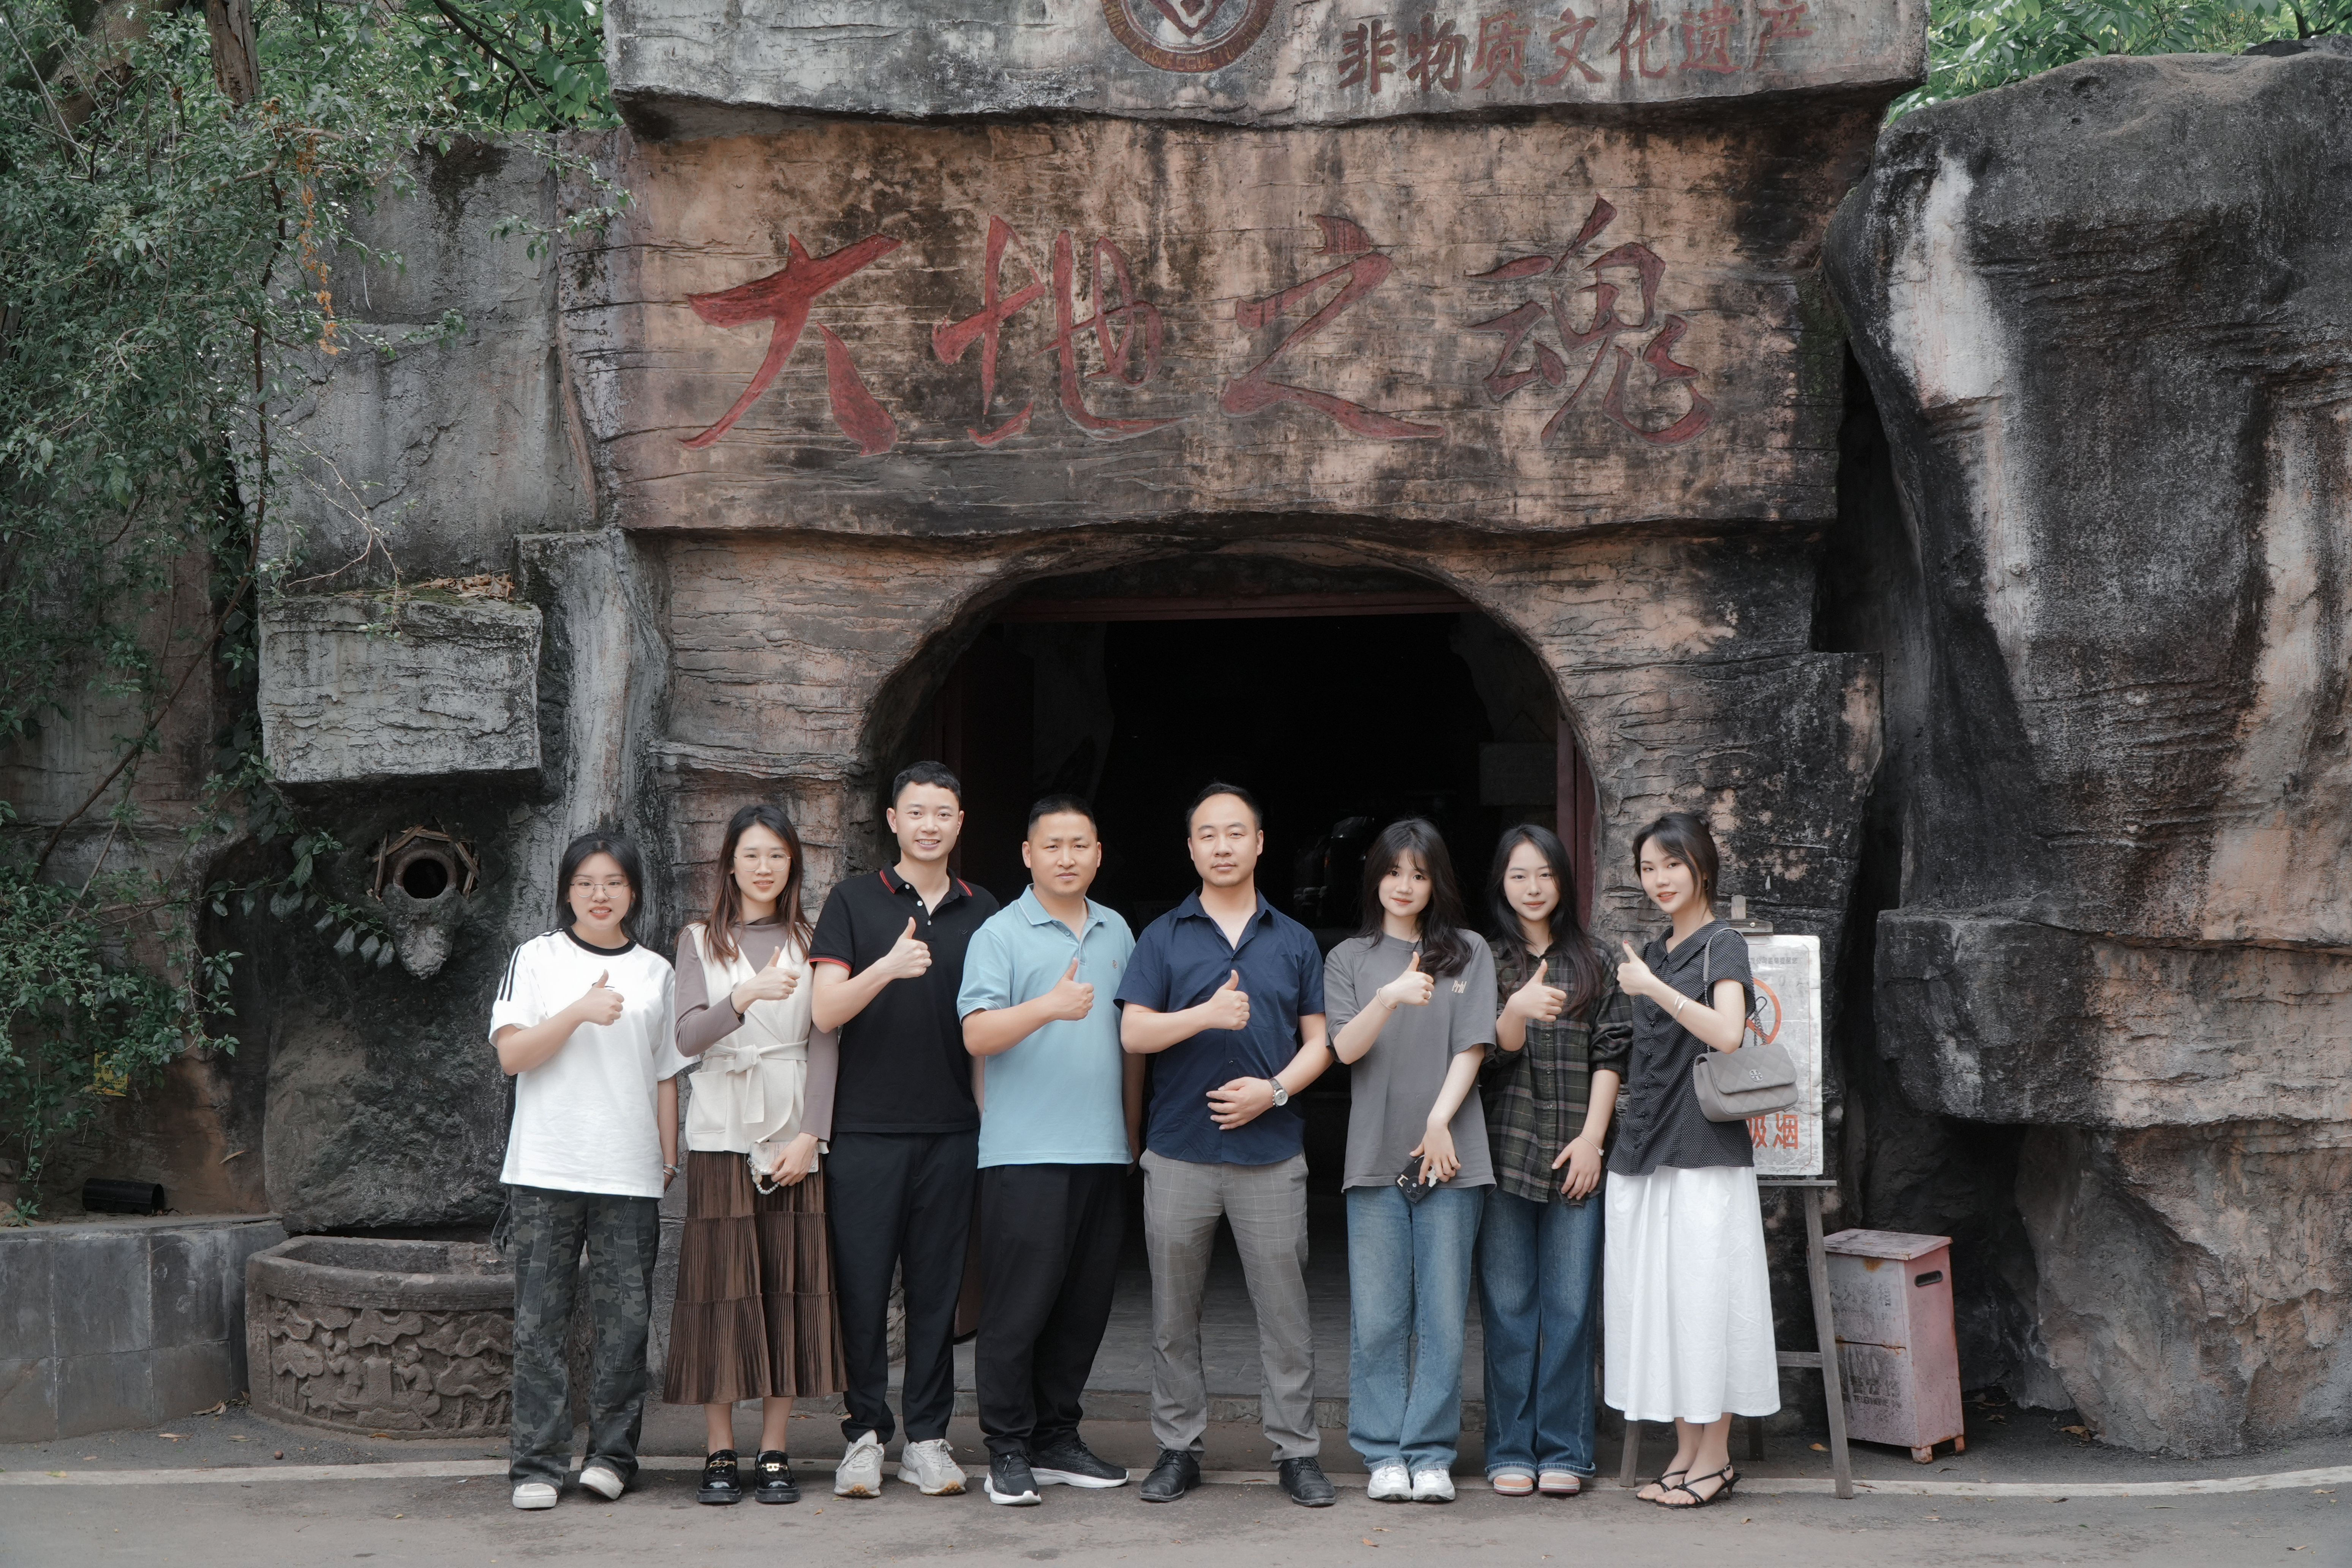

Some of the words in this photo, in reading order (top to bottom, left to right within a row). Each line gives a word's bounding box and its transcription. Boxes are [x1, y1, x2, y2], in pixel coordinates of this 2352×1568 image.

[1337, 0, 1814, 94] 非物质文化遗产
[678, 193, 1714, 456] 大地之魂
